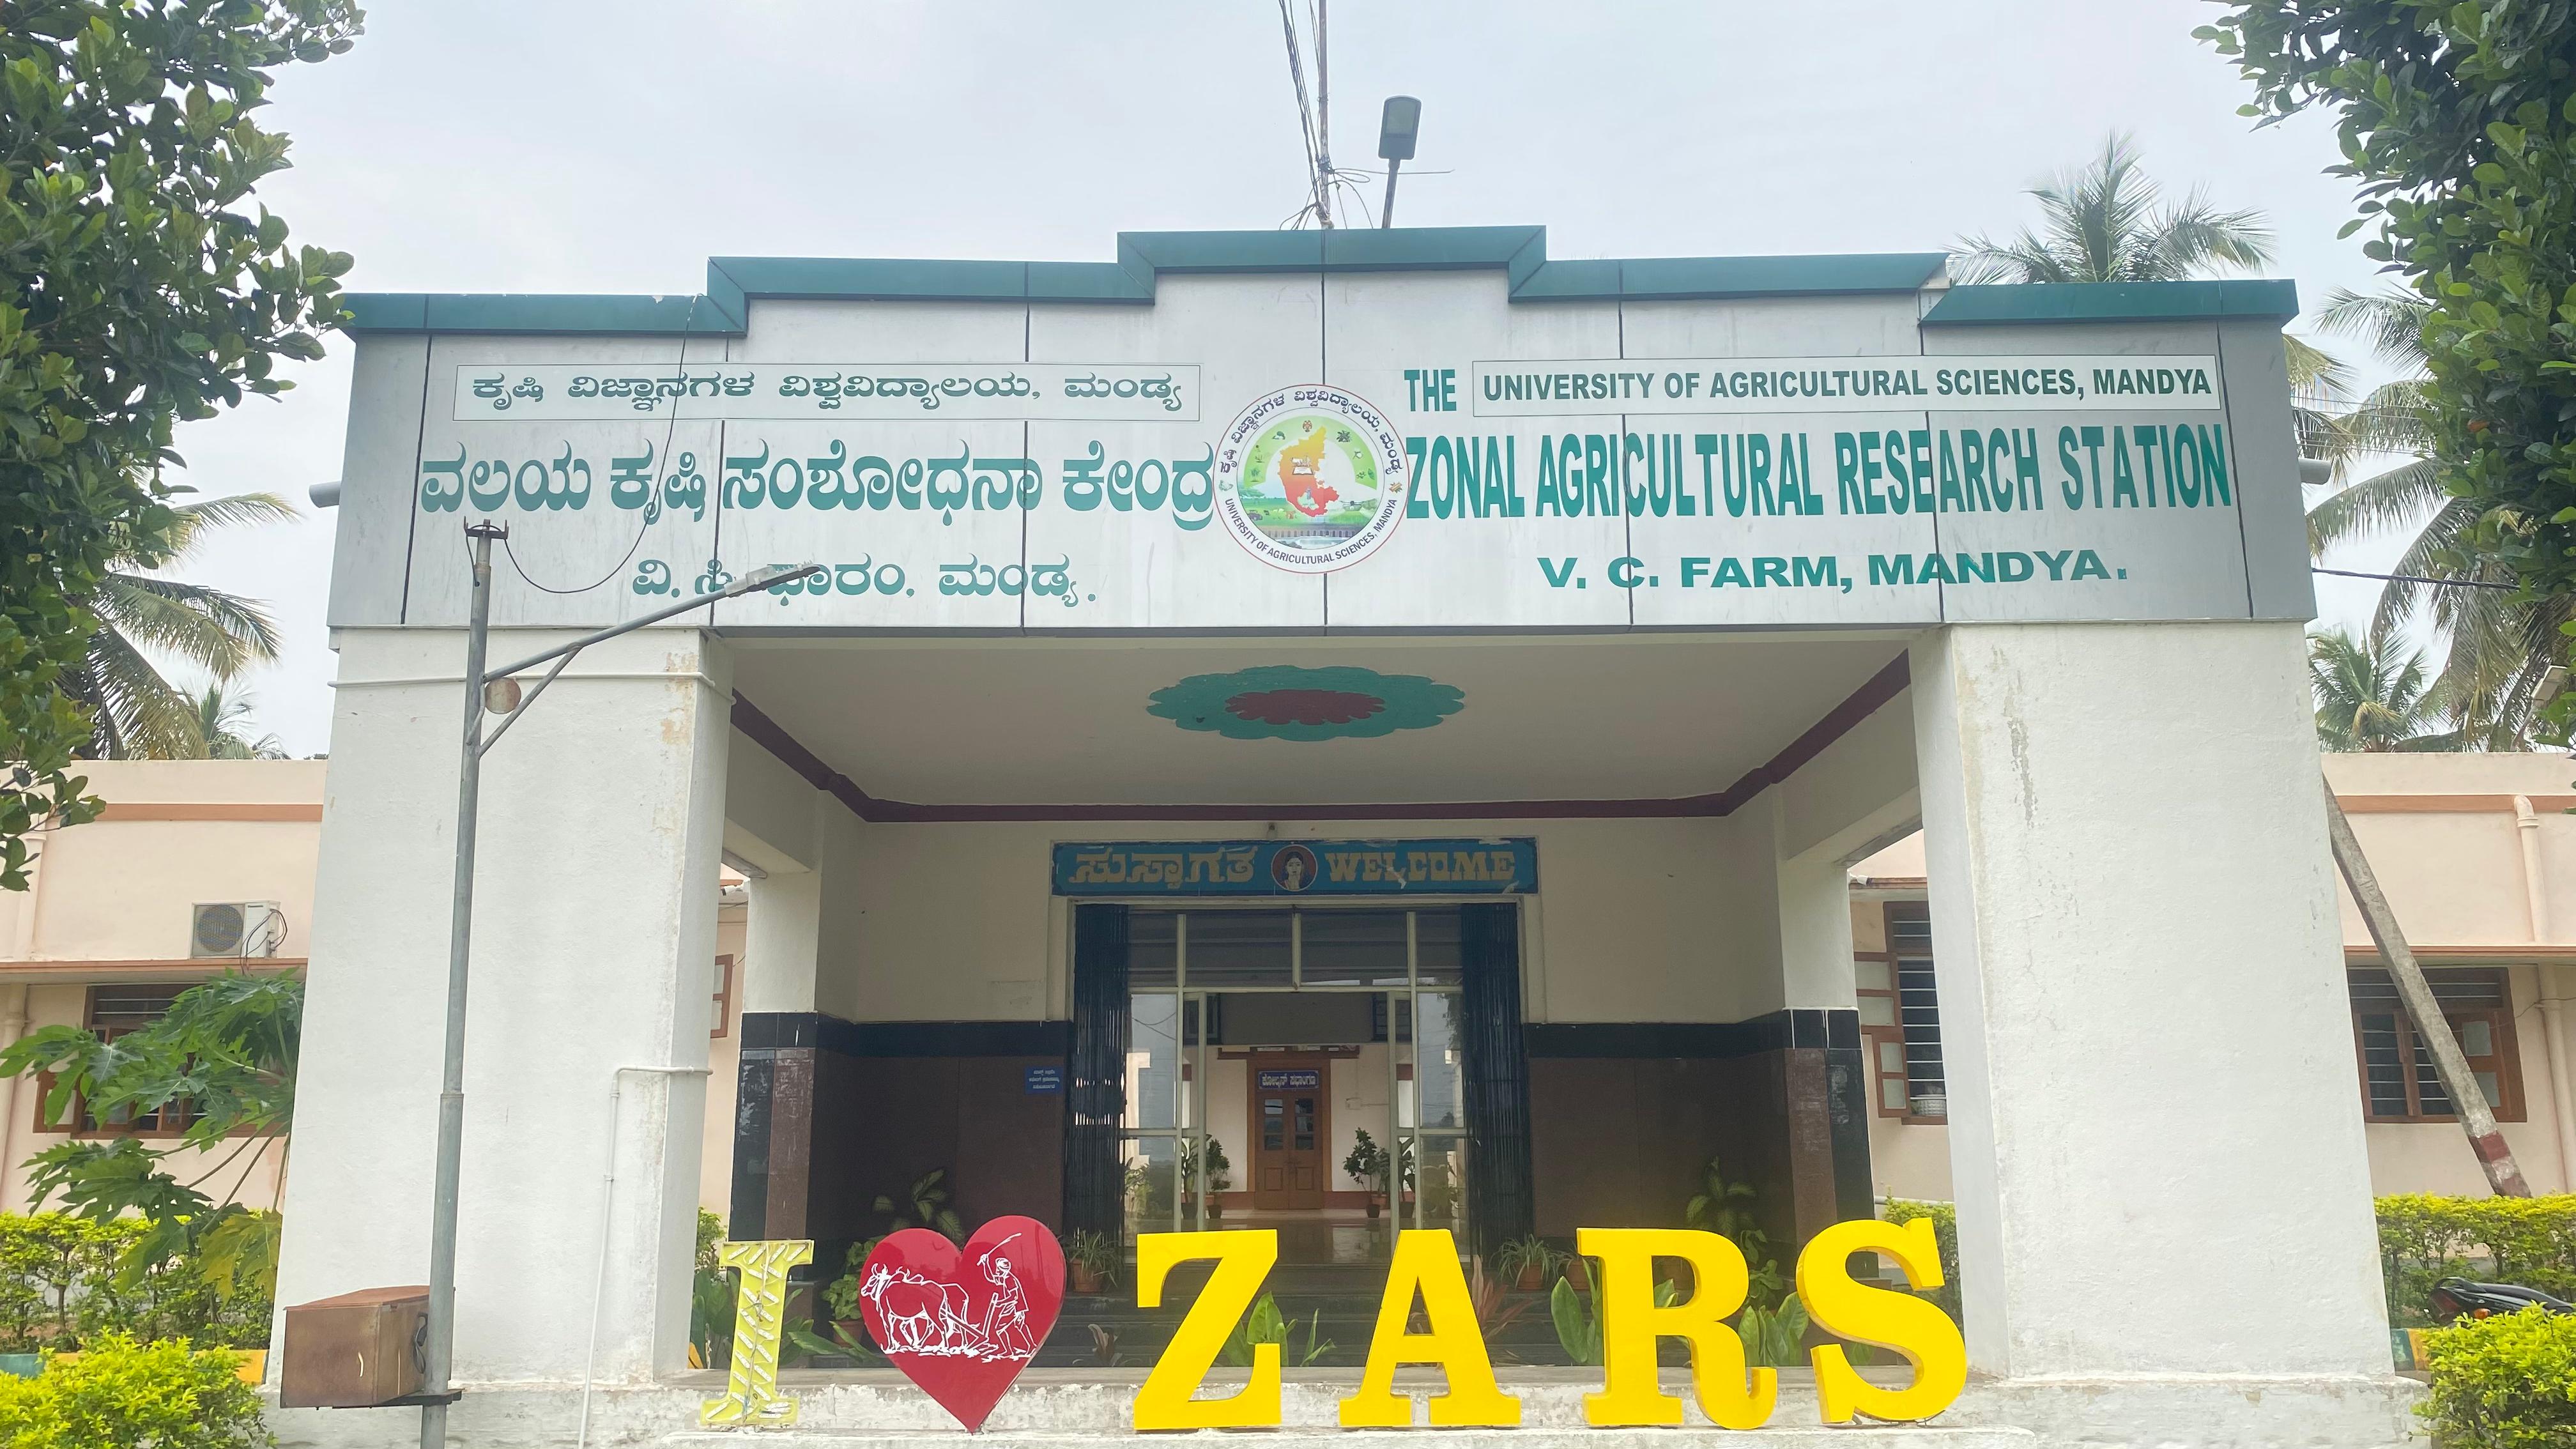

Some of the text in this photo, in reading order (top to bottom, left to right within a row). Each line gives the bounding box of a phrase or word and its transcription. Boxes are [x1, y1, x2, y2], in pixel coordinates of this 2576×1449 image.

[472, 371, 1182, 412] ಕೃಷಿ ವಿಜ್ಞಾನಗಳ ವಿಶ್ವವಿದ್ಯಾಲಯ, ಮಂಡ್ಯ
[1404, 369, 1457, 412] THE
[1483, 368, 2212, 401] UNIVERSITY OF AGRICULTURAL SCIENCES, MANDYA
[1220, 449, 1238, 473] ಕೃಷಿ
[1230, 393, 1285, 444] ವಿಜ್ಞಾನಗಳ
[1379, 432, 1404, 475] ಮಂಡ್ಯ
[420, 438, 1214, 531] ವಲಯ ಕೃಷಿ ಸಂಶೋಧನಾ ಕೇಂದ್ರ
[1406, 422, 2232, 521] ZONAL AGRICULTURAL RESEARCH STATION
[1225, 498, 1398, 565] UNIVERSITY OF AGRICULTURAL SCIENCES, MANDYA
[632, 558, 680, 598] ವಿ.
[938, 552, 1096, 608] ಮಂಡ್ಯ.
[1537, 549, 2128, 594] V. C. FARM, MANDYA.
[1068, 846, 1259, 890] ಸುಸ್ವಾಗತ
[1324, 850, 1516, 882] WELCOME
[700, 1217, 1968, 1430] I ZARS
